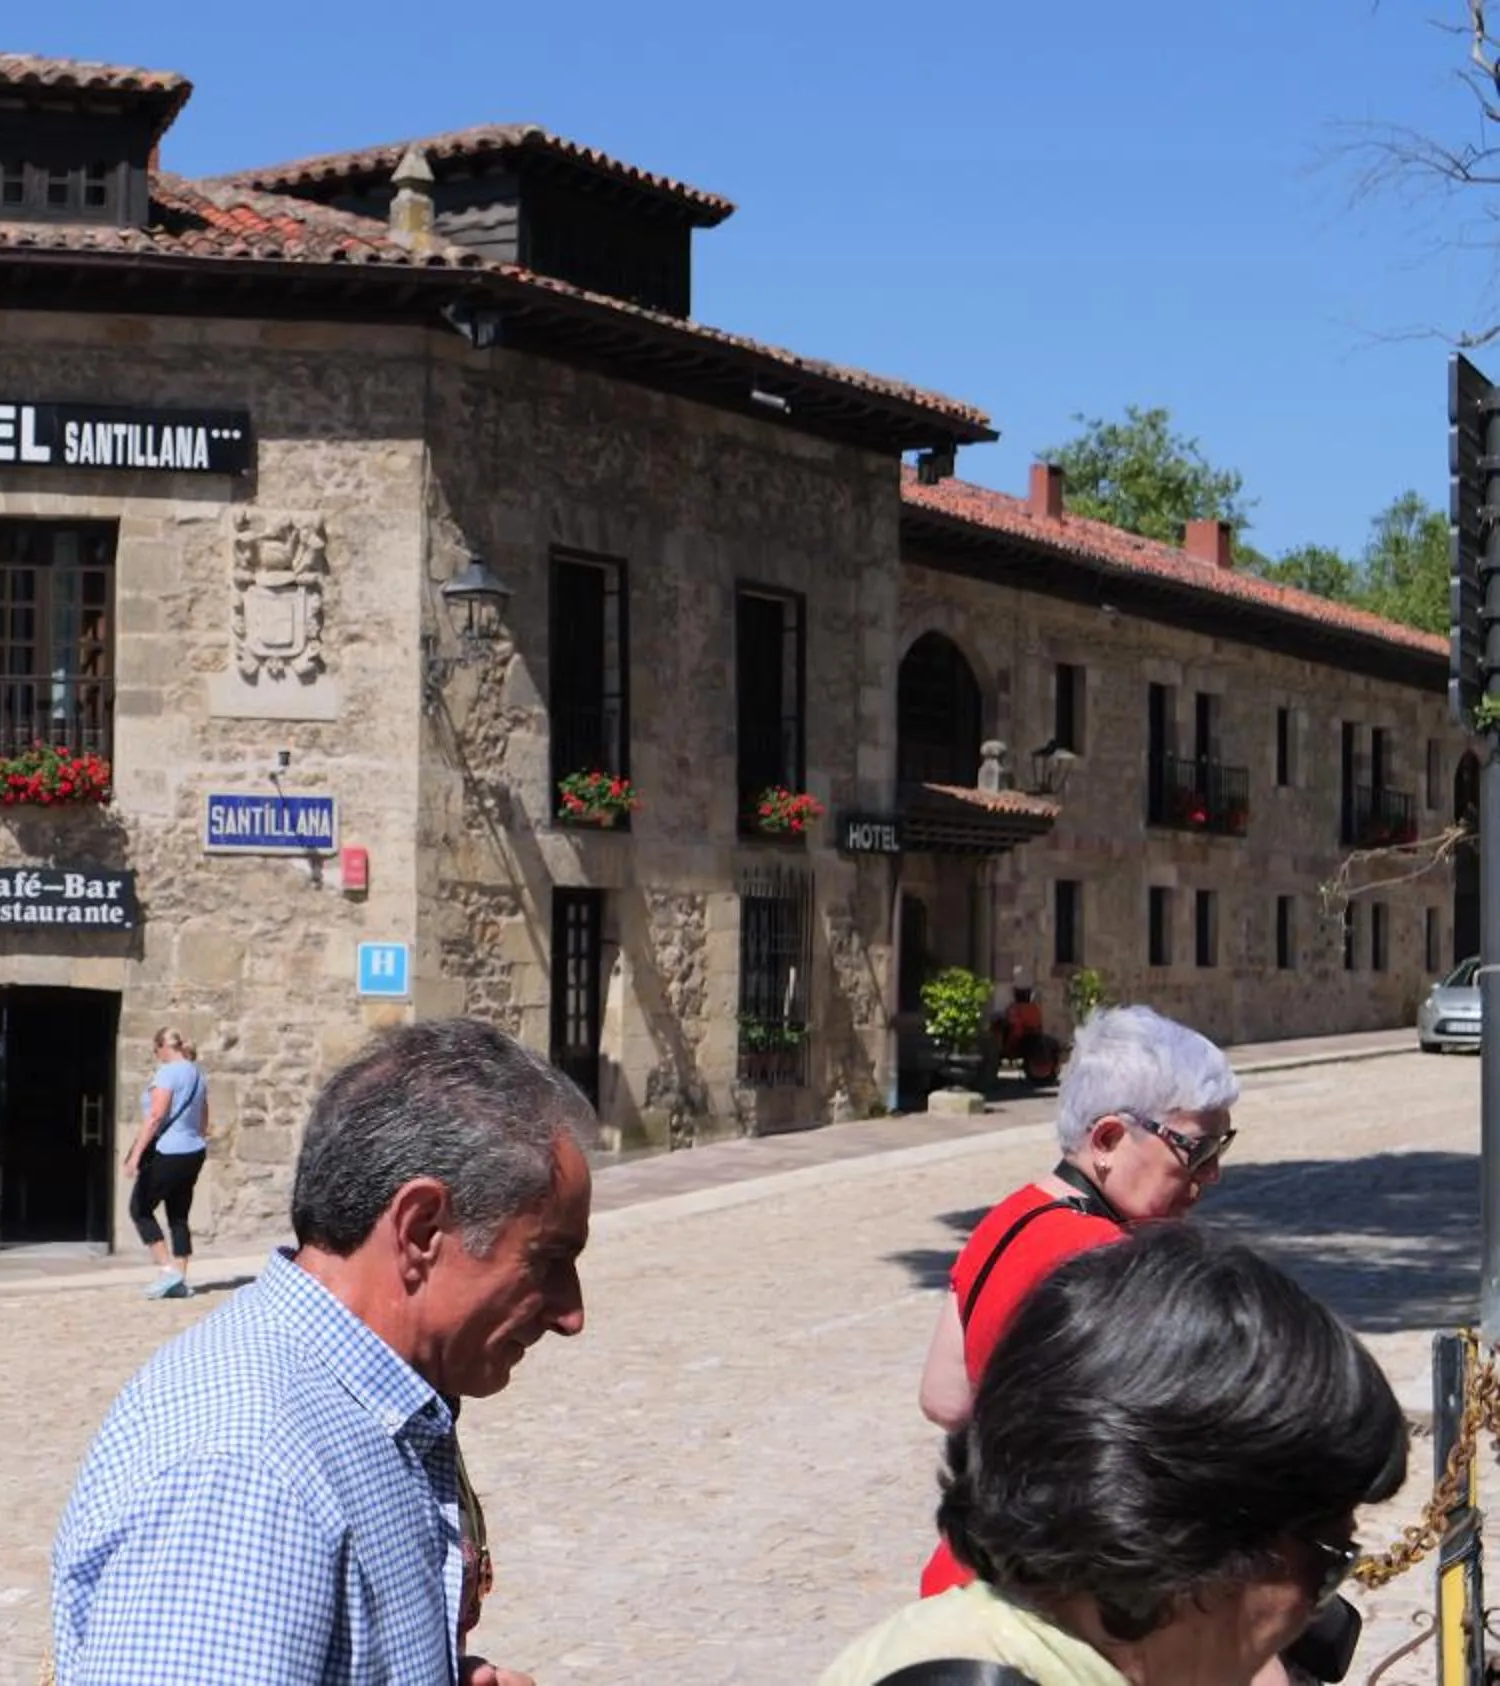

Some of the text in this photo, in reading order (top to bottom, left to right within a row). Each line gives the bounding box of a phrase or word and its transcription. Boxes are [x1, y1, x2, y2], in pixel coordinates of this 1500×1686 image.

[64, 420, 210, 469] SANTILLANA
[849, 822, 900, 852] HOTEL
[372, 950, 395, 976] H
